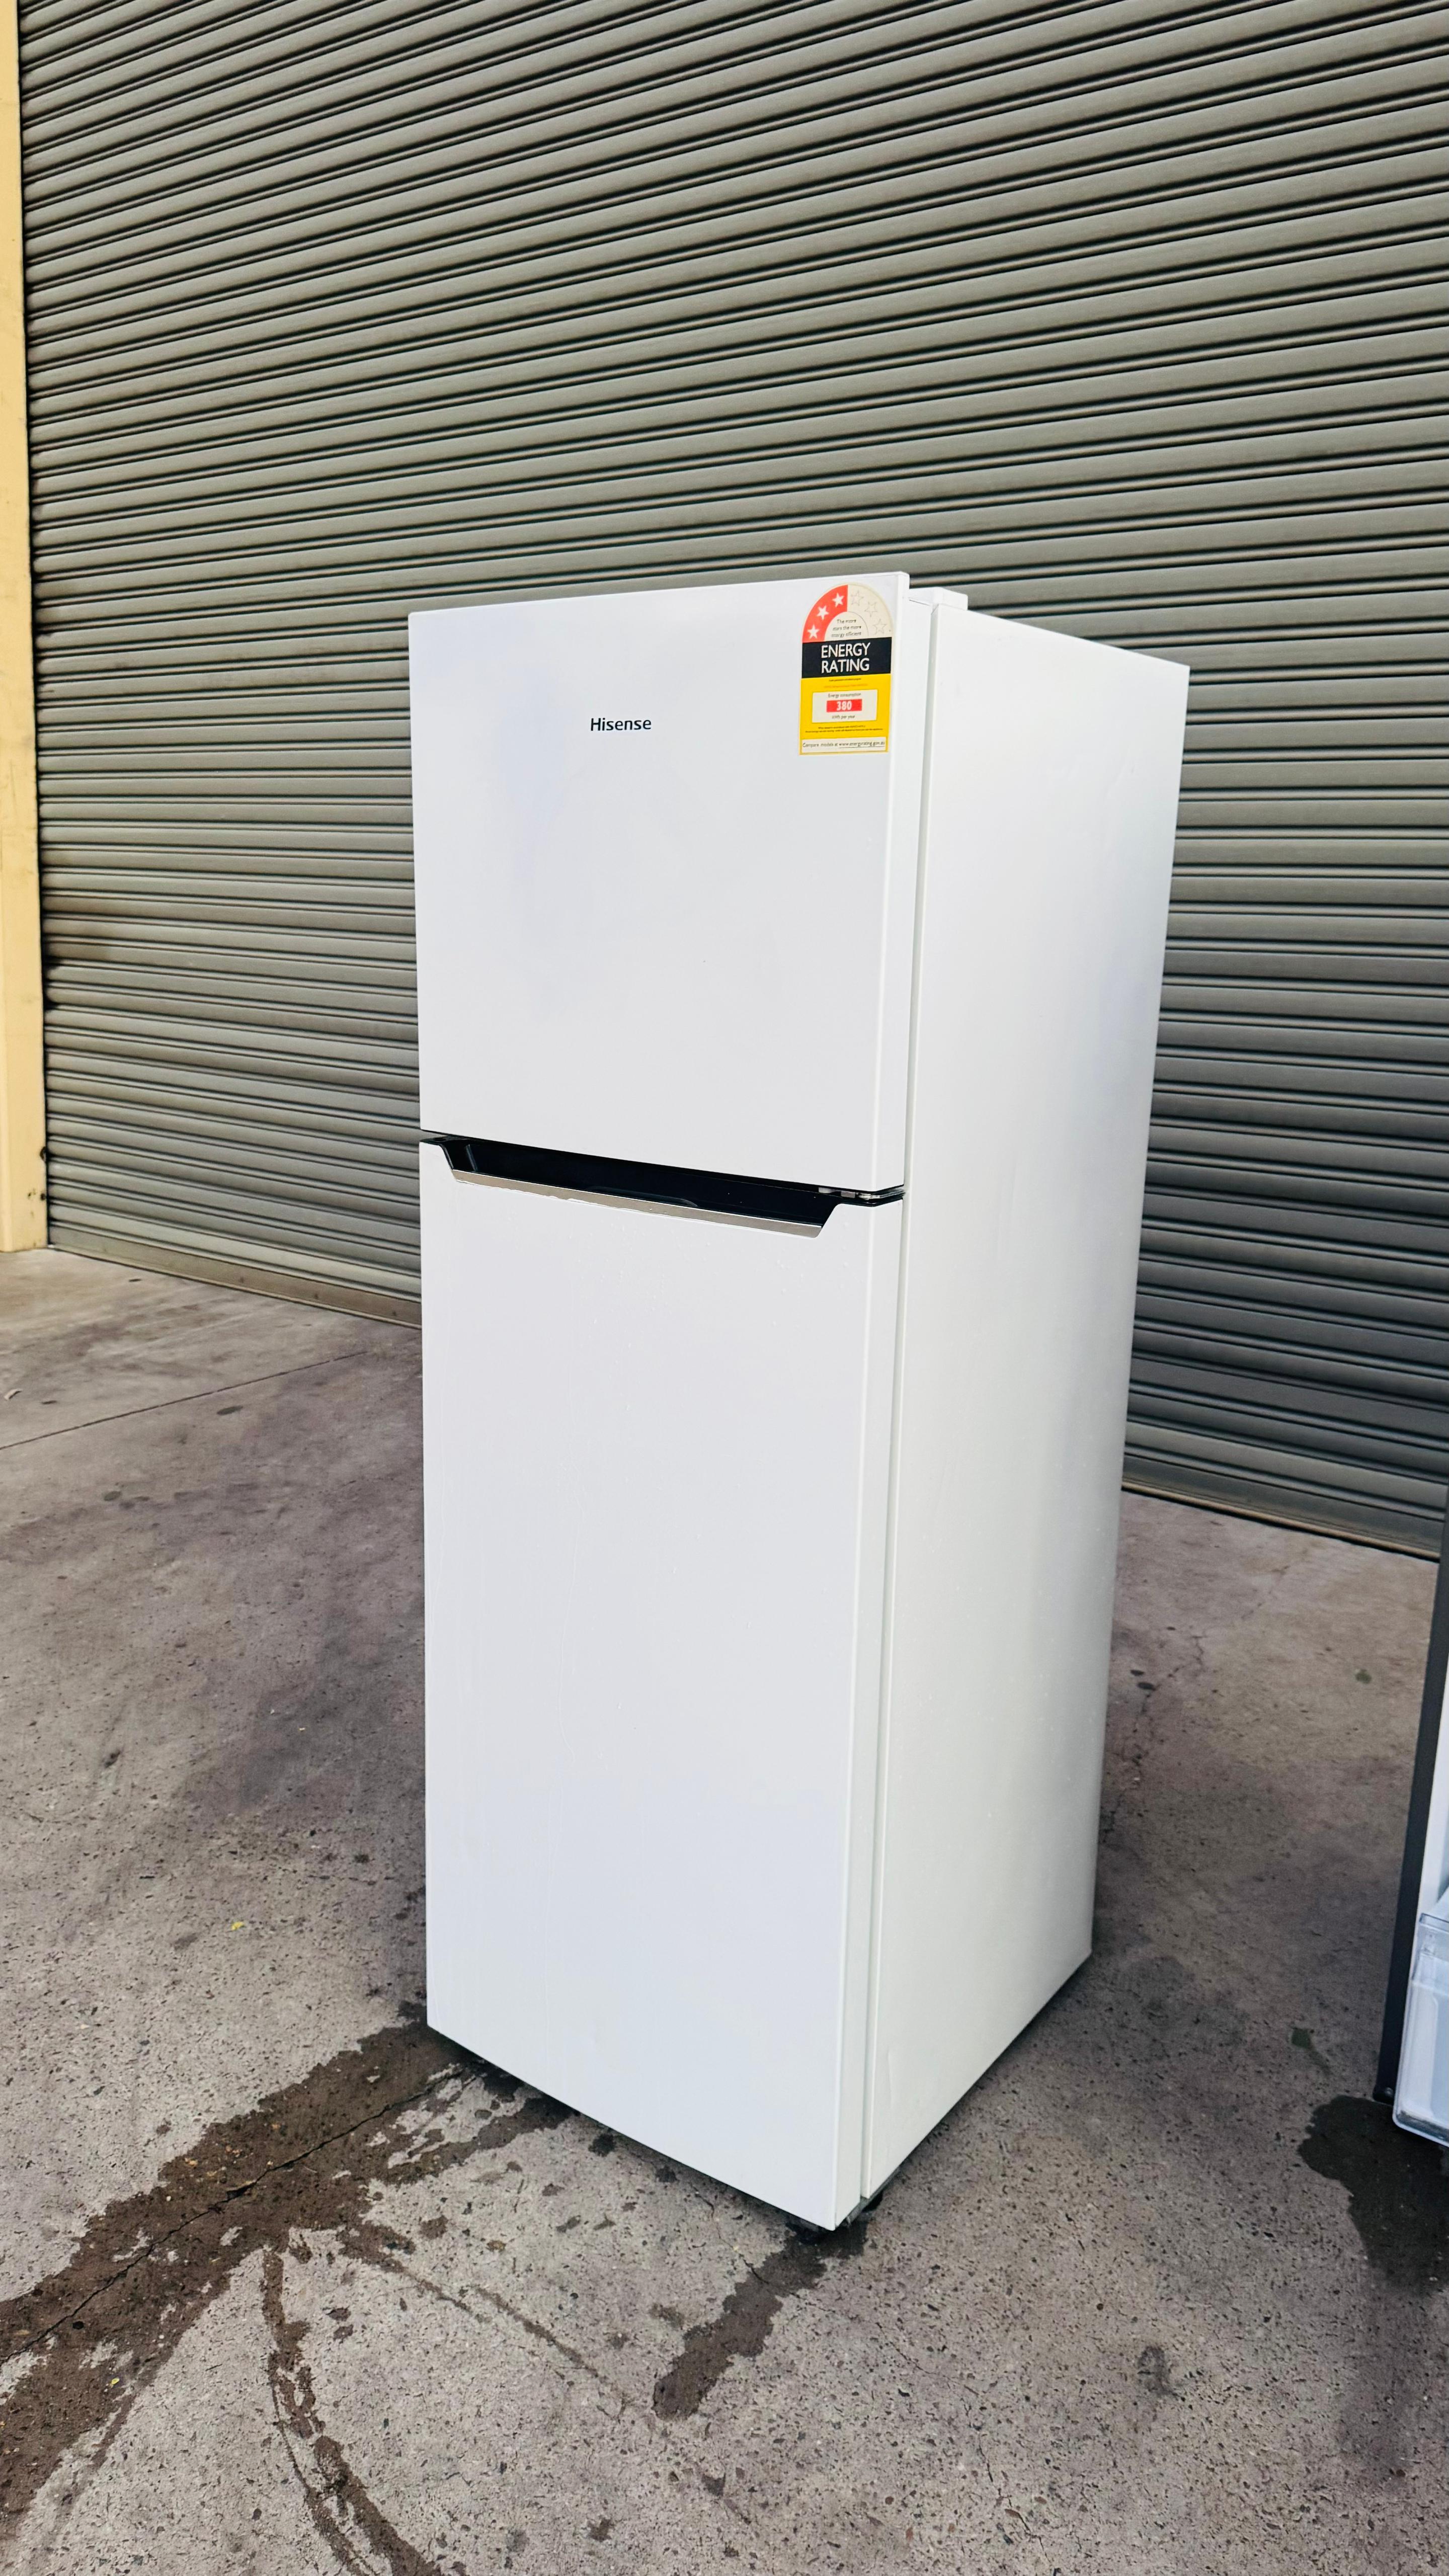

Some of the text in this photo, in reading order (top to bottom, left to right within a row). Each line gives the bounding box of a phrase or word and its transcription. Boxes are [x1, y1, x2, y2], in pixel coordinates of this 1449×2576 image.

[821, 642, 870, 658] ENERGY
[821, 658, 870, 674] RATING
[836, 700, 852, 711] 380
[591, 717, 652, 731] Hisense
